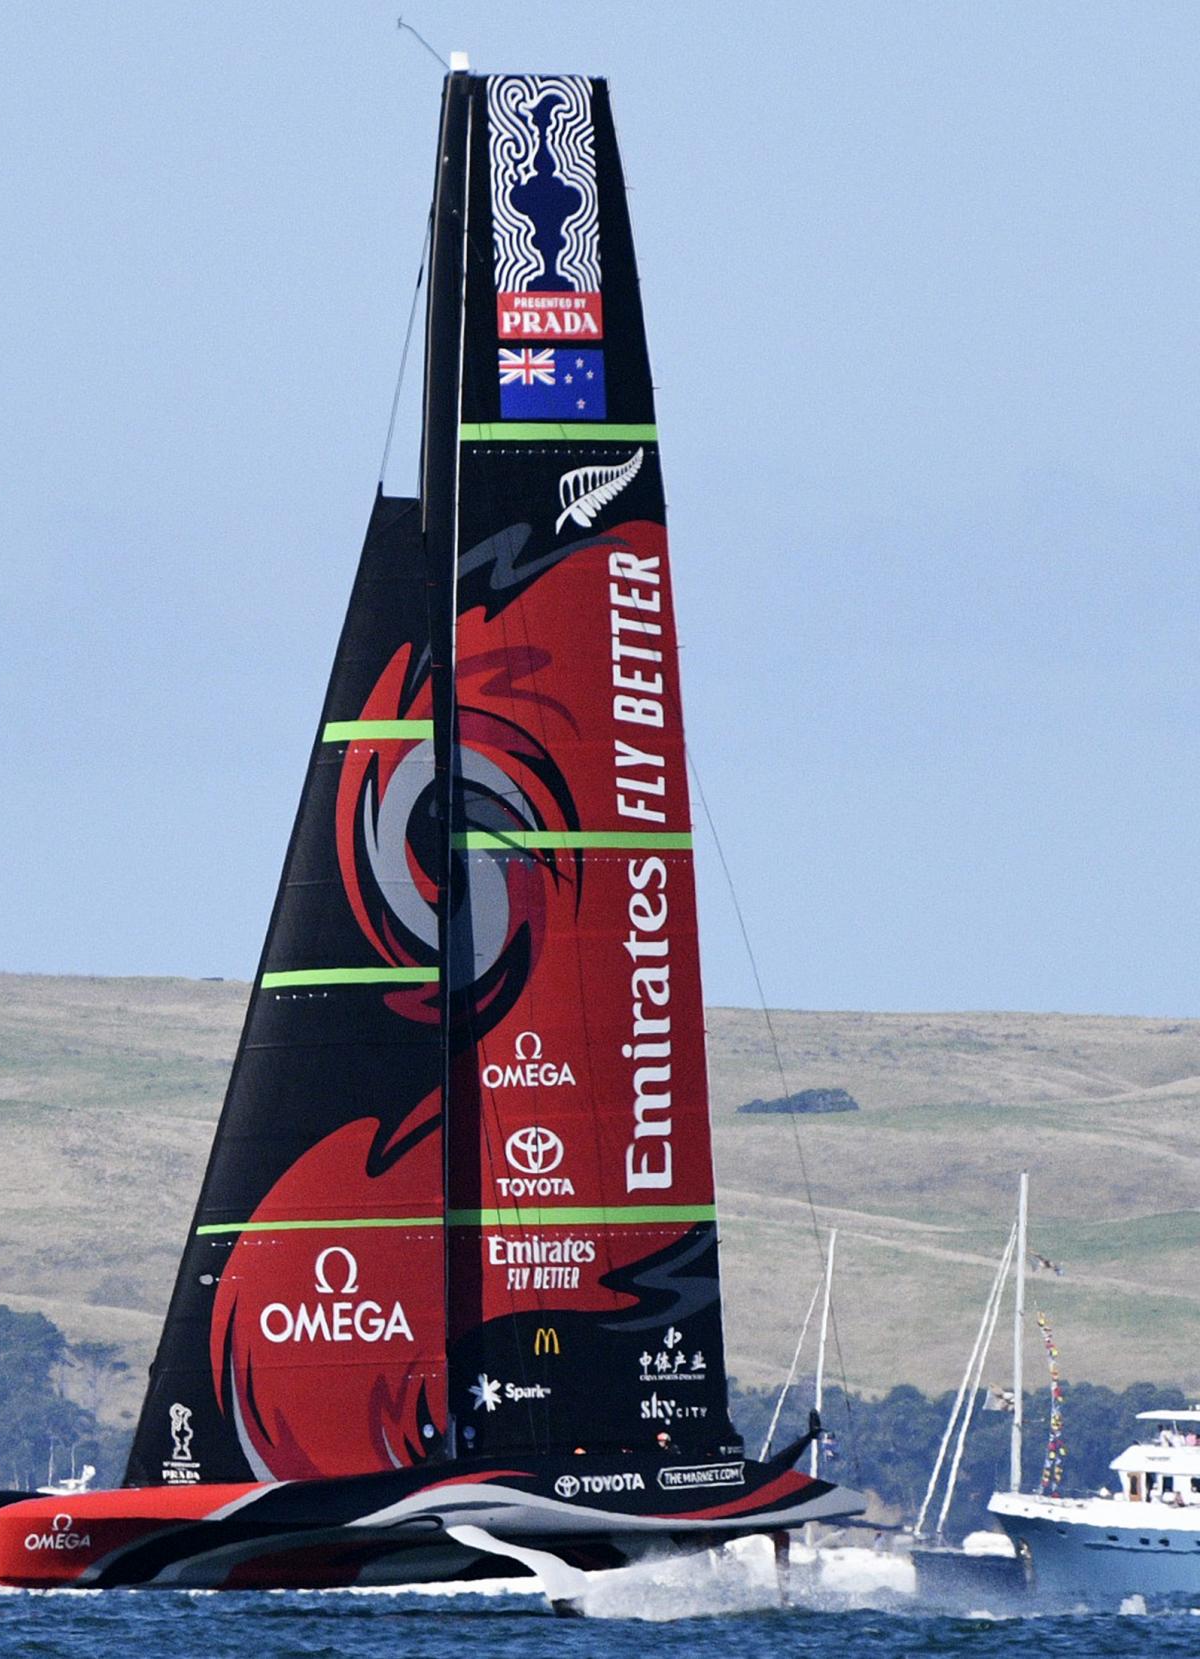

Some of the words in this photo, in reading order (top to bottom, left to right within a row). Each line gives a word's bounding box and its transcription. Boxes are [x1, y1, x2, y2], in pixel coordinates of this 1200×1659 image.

[514, 297, 571, 308] PRESENTED
[574, 298, 587, 308] BY
[502, 311, 598, 333] PRADA
[609, 552, 664, 727] BETTER
[614, 740, 666, 823] FLY
[622, 856, 673, 1194] Emirates
[482, 1063, 576, 1088] OMEGA
[497, 1178, 575, 1197] TOYOTA
[488, 1235, 596, 1264] Emirates
[507, 1267, 530, 1290] FLY
[533, 1266, 580, 1289] BETTER
[260, 1301, 414, 1342] OMEGA
[505, 1382, 545, 1402] Spark
[582, 1473, 646, 1493] TOYOTA
[24, 1533, 91, 1551] OMEGA
